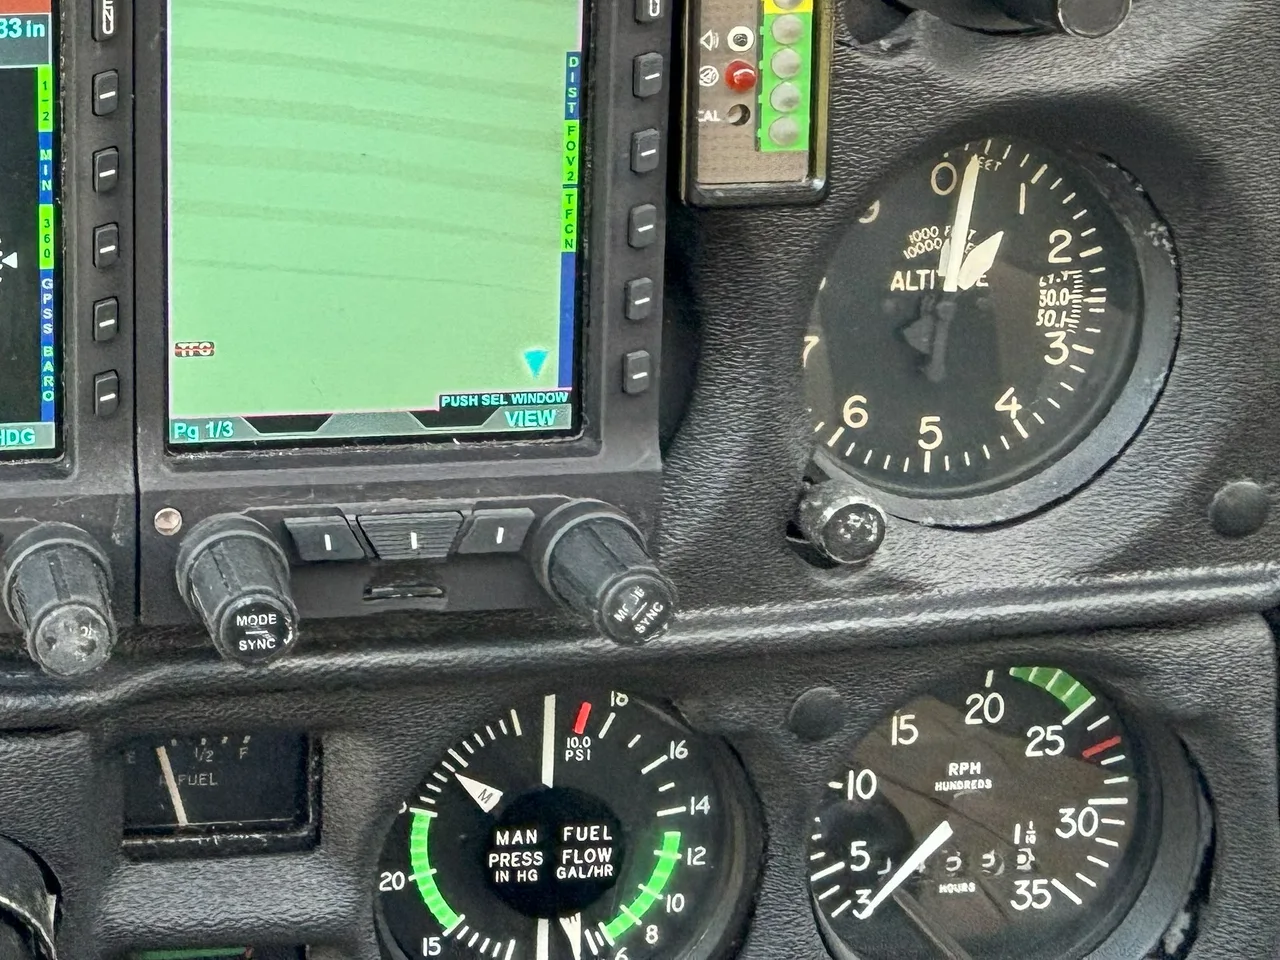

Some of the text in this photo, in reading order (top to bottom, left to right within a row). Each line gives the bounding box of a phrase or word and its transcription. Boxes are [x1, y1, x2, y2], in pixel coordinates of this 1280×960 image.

[930, 161, 958, 196] 0
[1047, 229, 1073, 264] 2
[890, 269, 989, 292] ALTIE
[1044, 331, 1069, 366] 3
[441, 391, 569, 407] PUSH SEL WINDOW
[994, 387, 1022, 419] 4
[504, 408, 557, 428] VIEW
[843, 395, 869, 429] 6
[174, 420, 234, 440] Pg 1/3
[917, 416, 943, 450] 5
[236, 613, 277, 626] MODE
[634, 601, 664, 634] SYNC
[238, 638, 276, 651] SYNC
[964, 692, 1005, 725] 20
[891, 714, 919, 746] 15
[565, 736, 591, 749] 10.0
[669, 741, 688, 759] 16
[1025, 724, 1066, 758] 25
[565, 749, 591, 762] PSI
[948, 760, 981, 776] RPM
[177, 772, 218, 786] FUEL
[934, 778, 993, 792] HUNDREDS
[689, 796, 710, 815] 14
[1056, 806, 1100, 839] 30
[495, 829, 538, 846] MAN
[563, 825, 613, 841] FUEL
[488, 851, 544, 868] PRESS
[562, 847, 612, 864] FLOW
[687, 847, 707, 866] 12
[495, 869, 538, 883] IN HG
[556, 864, 614, 880] GAL/HR
[939, 882, 976, 894] HOURS
[1010, 878, 1053, 910] 35
